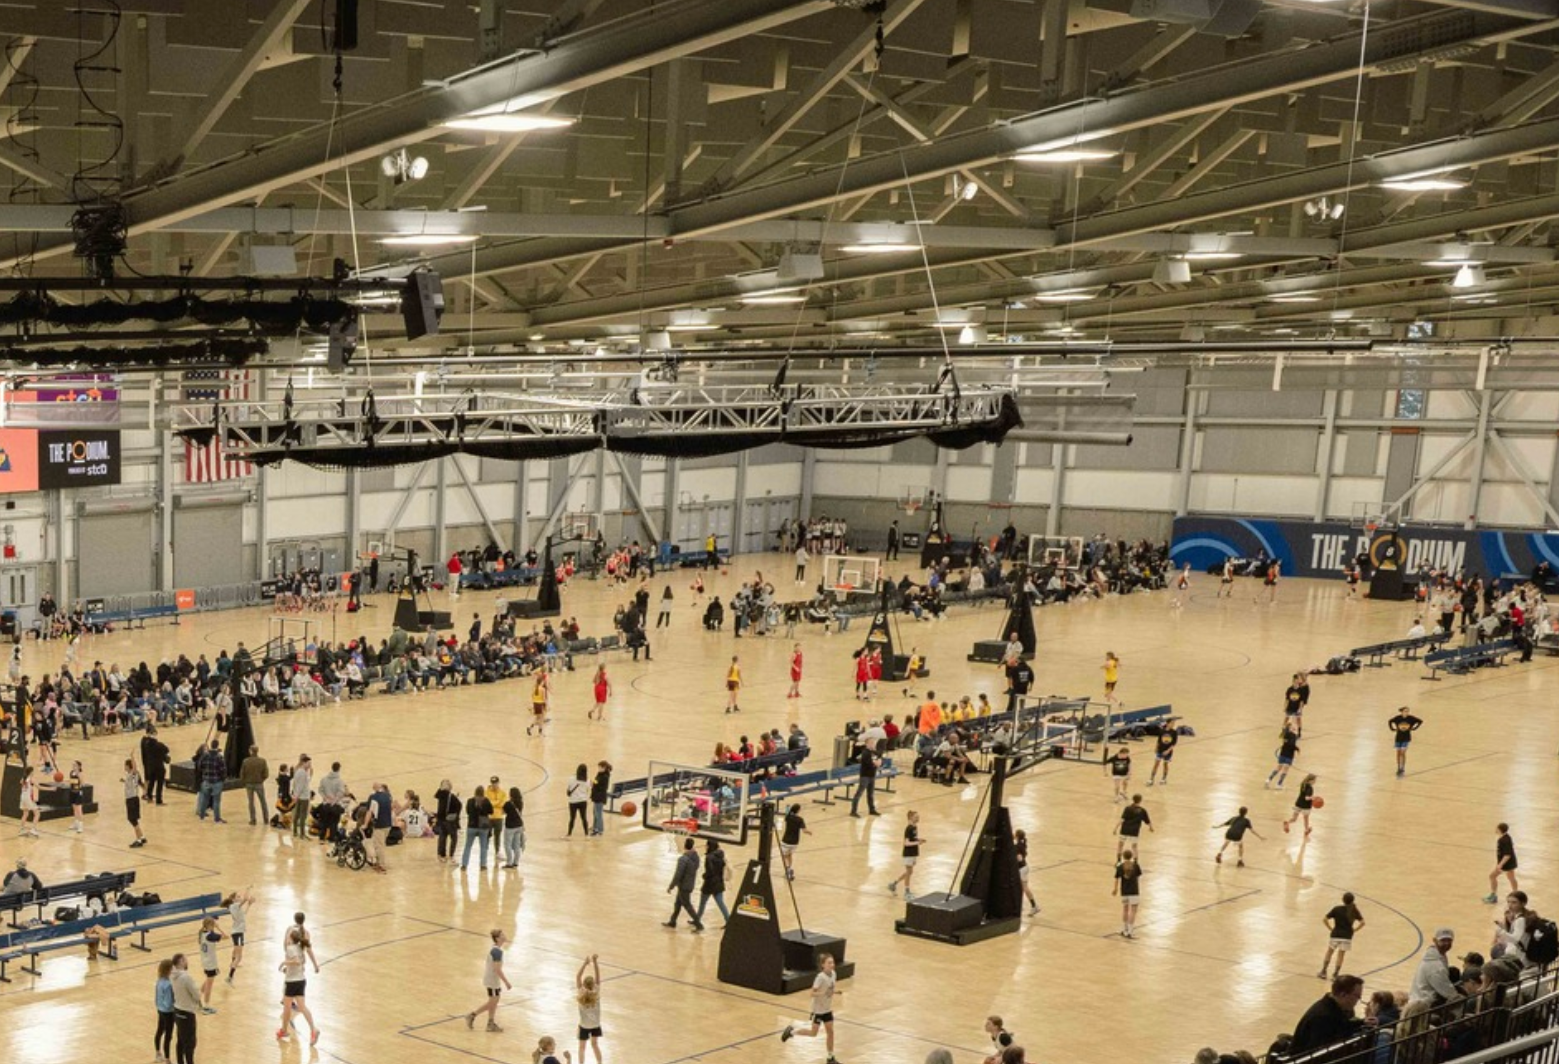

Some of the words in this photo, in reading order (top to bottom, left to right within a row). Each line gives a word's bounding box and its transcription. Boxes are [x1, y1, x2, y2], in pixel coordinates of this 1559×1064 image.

[48, 443, 64, 463] THE
[1311, 533, 1349, 571] THE
[11, 730, 19, 745] 2
[408, 814, 419, 826] 21
[752, 864, 762, 884] 1
